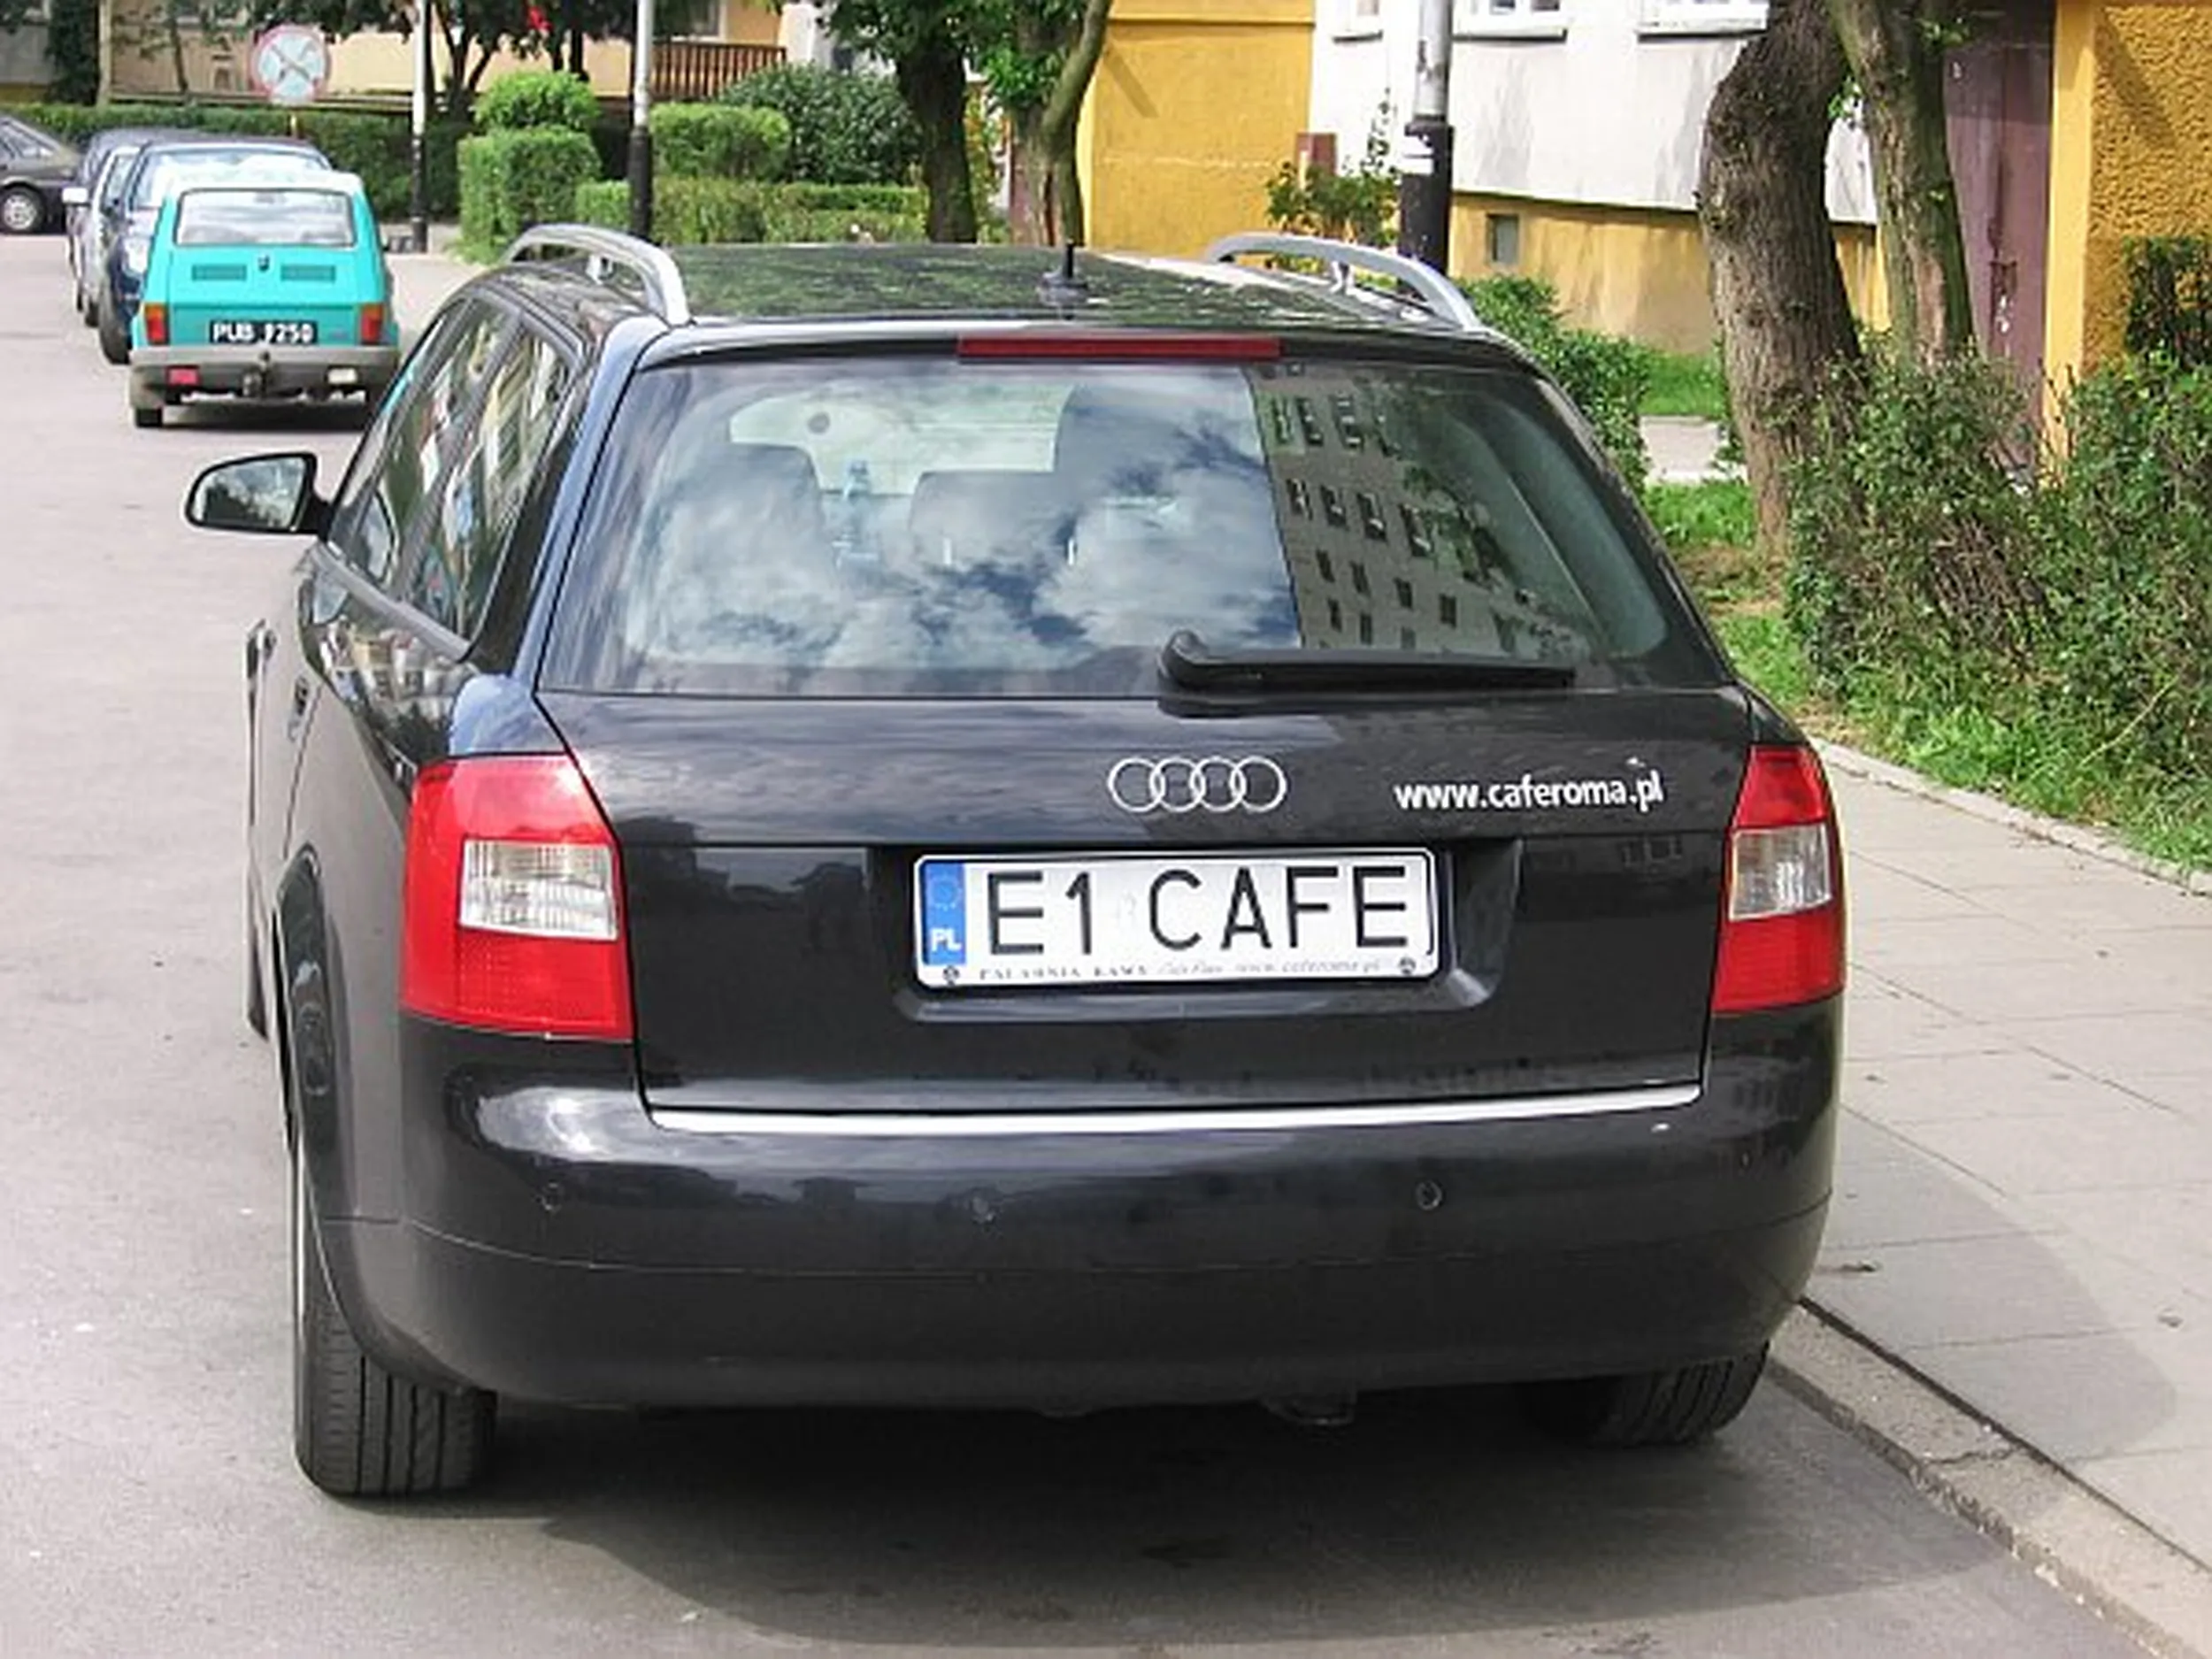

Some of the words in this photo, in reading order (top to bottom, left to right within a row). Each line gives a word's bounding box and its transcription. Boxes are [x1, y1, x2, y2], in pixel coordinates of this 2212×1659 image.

[1394, 769, 1664, 812] www.caferoma.pl
[987, 871, 1092, 955] E1
[1148, 864, 1409, 951] CAFE
[931, 928, 962, 951] PL
